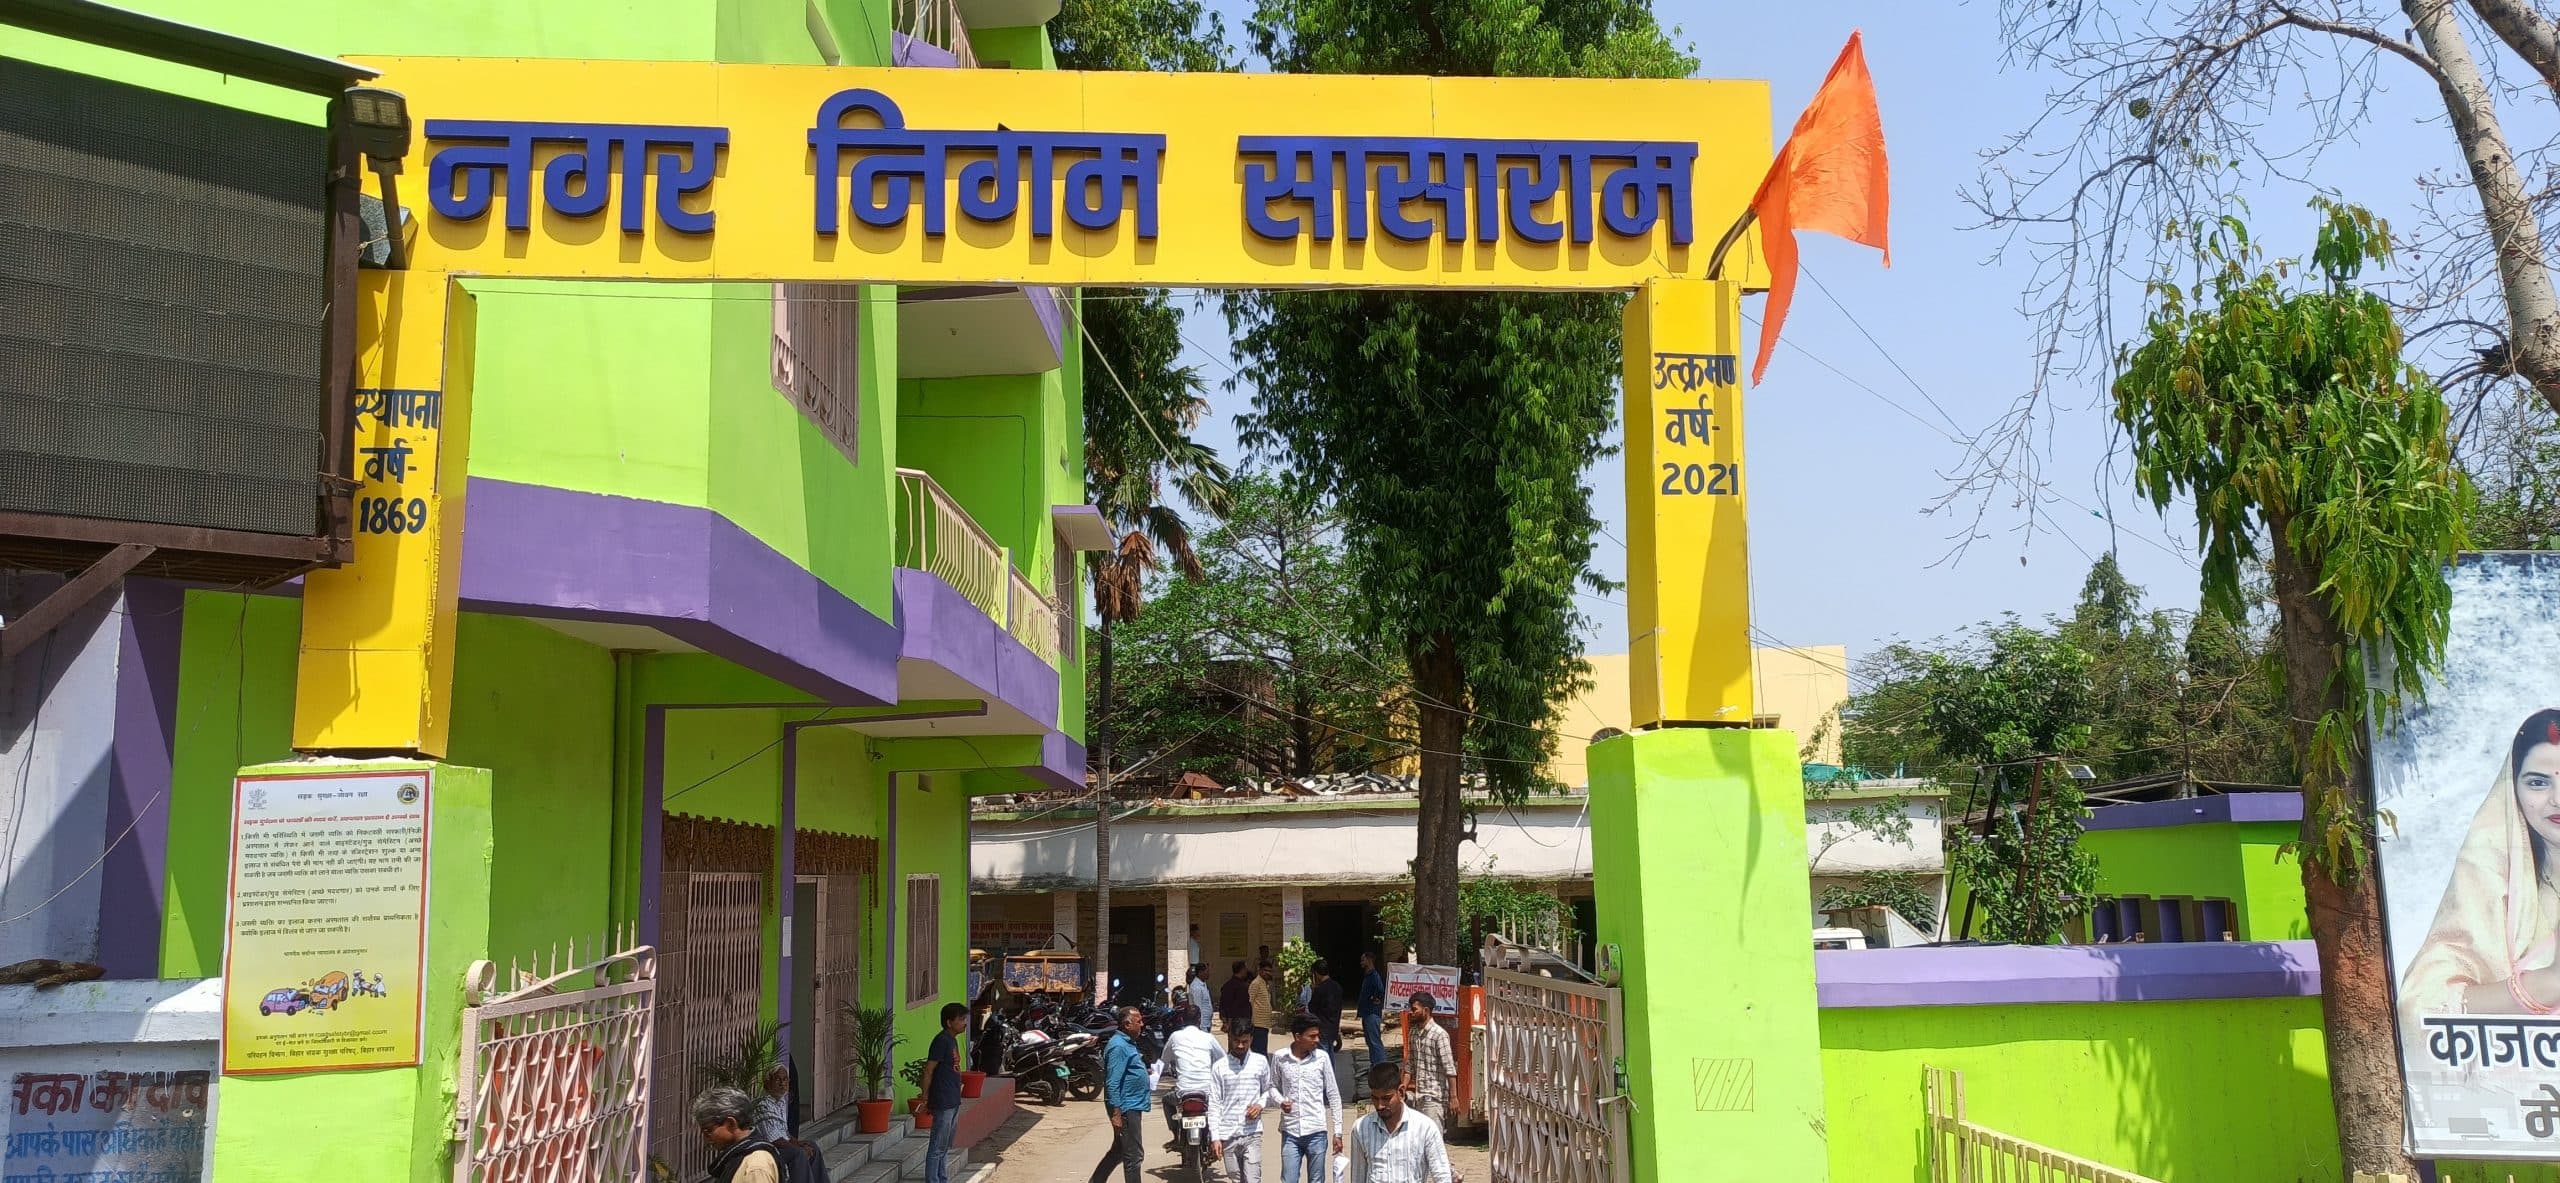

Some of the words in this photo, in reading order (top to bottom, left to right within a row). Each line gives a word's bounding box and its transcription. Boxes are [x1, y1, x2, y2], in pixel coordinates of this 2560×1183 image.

[424, 119, 729, 235] नगर
[807, 87, 1166, 239] निगम
[1238, 135, 1698, 245] सासाराम
[1654, 352, 1736, 393] उत्क्रमण
[353, 388, 441, 432] स्थापना
[1661, 463, 1739, 495] 2021
[359, 497, 427, 534] 1869
